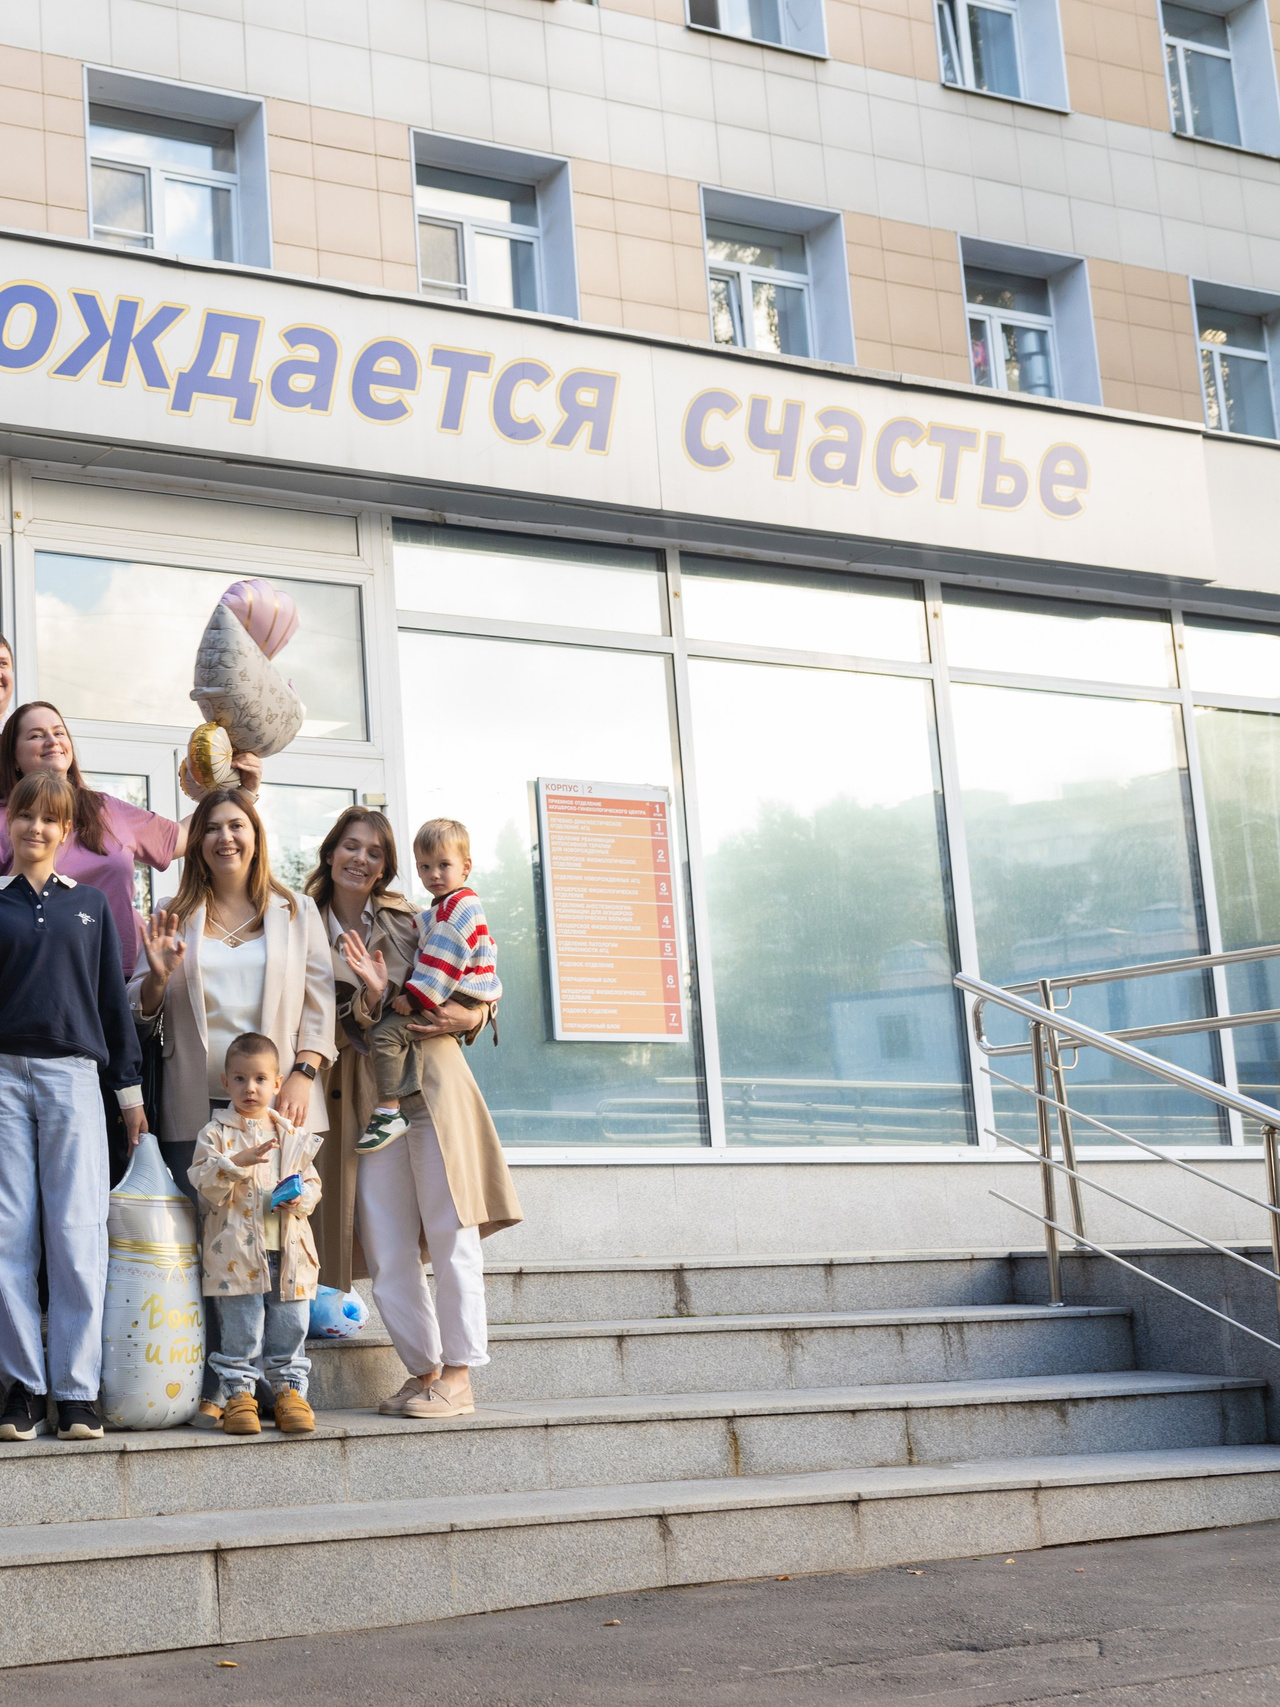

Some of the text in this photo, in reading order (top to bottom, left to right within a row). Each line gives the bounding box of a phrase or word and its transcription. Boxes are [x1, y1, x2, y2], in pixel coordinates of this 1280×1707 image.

[682, 387, 1091, 520] счастье
[545, 783, 593, 794] КОРПУС 2
[655, 803, 660, 813] 1
[656, 822, 661, 831] 1
[657, 849, 665, 859] 2
[660, 882, 667, 892] 3
[662, 915, 670, 925] 4
[664, 943, 671, 953] 5
[666, 975, 674, 985] 6
[669, 1013, 677, 1023] 7
